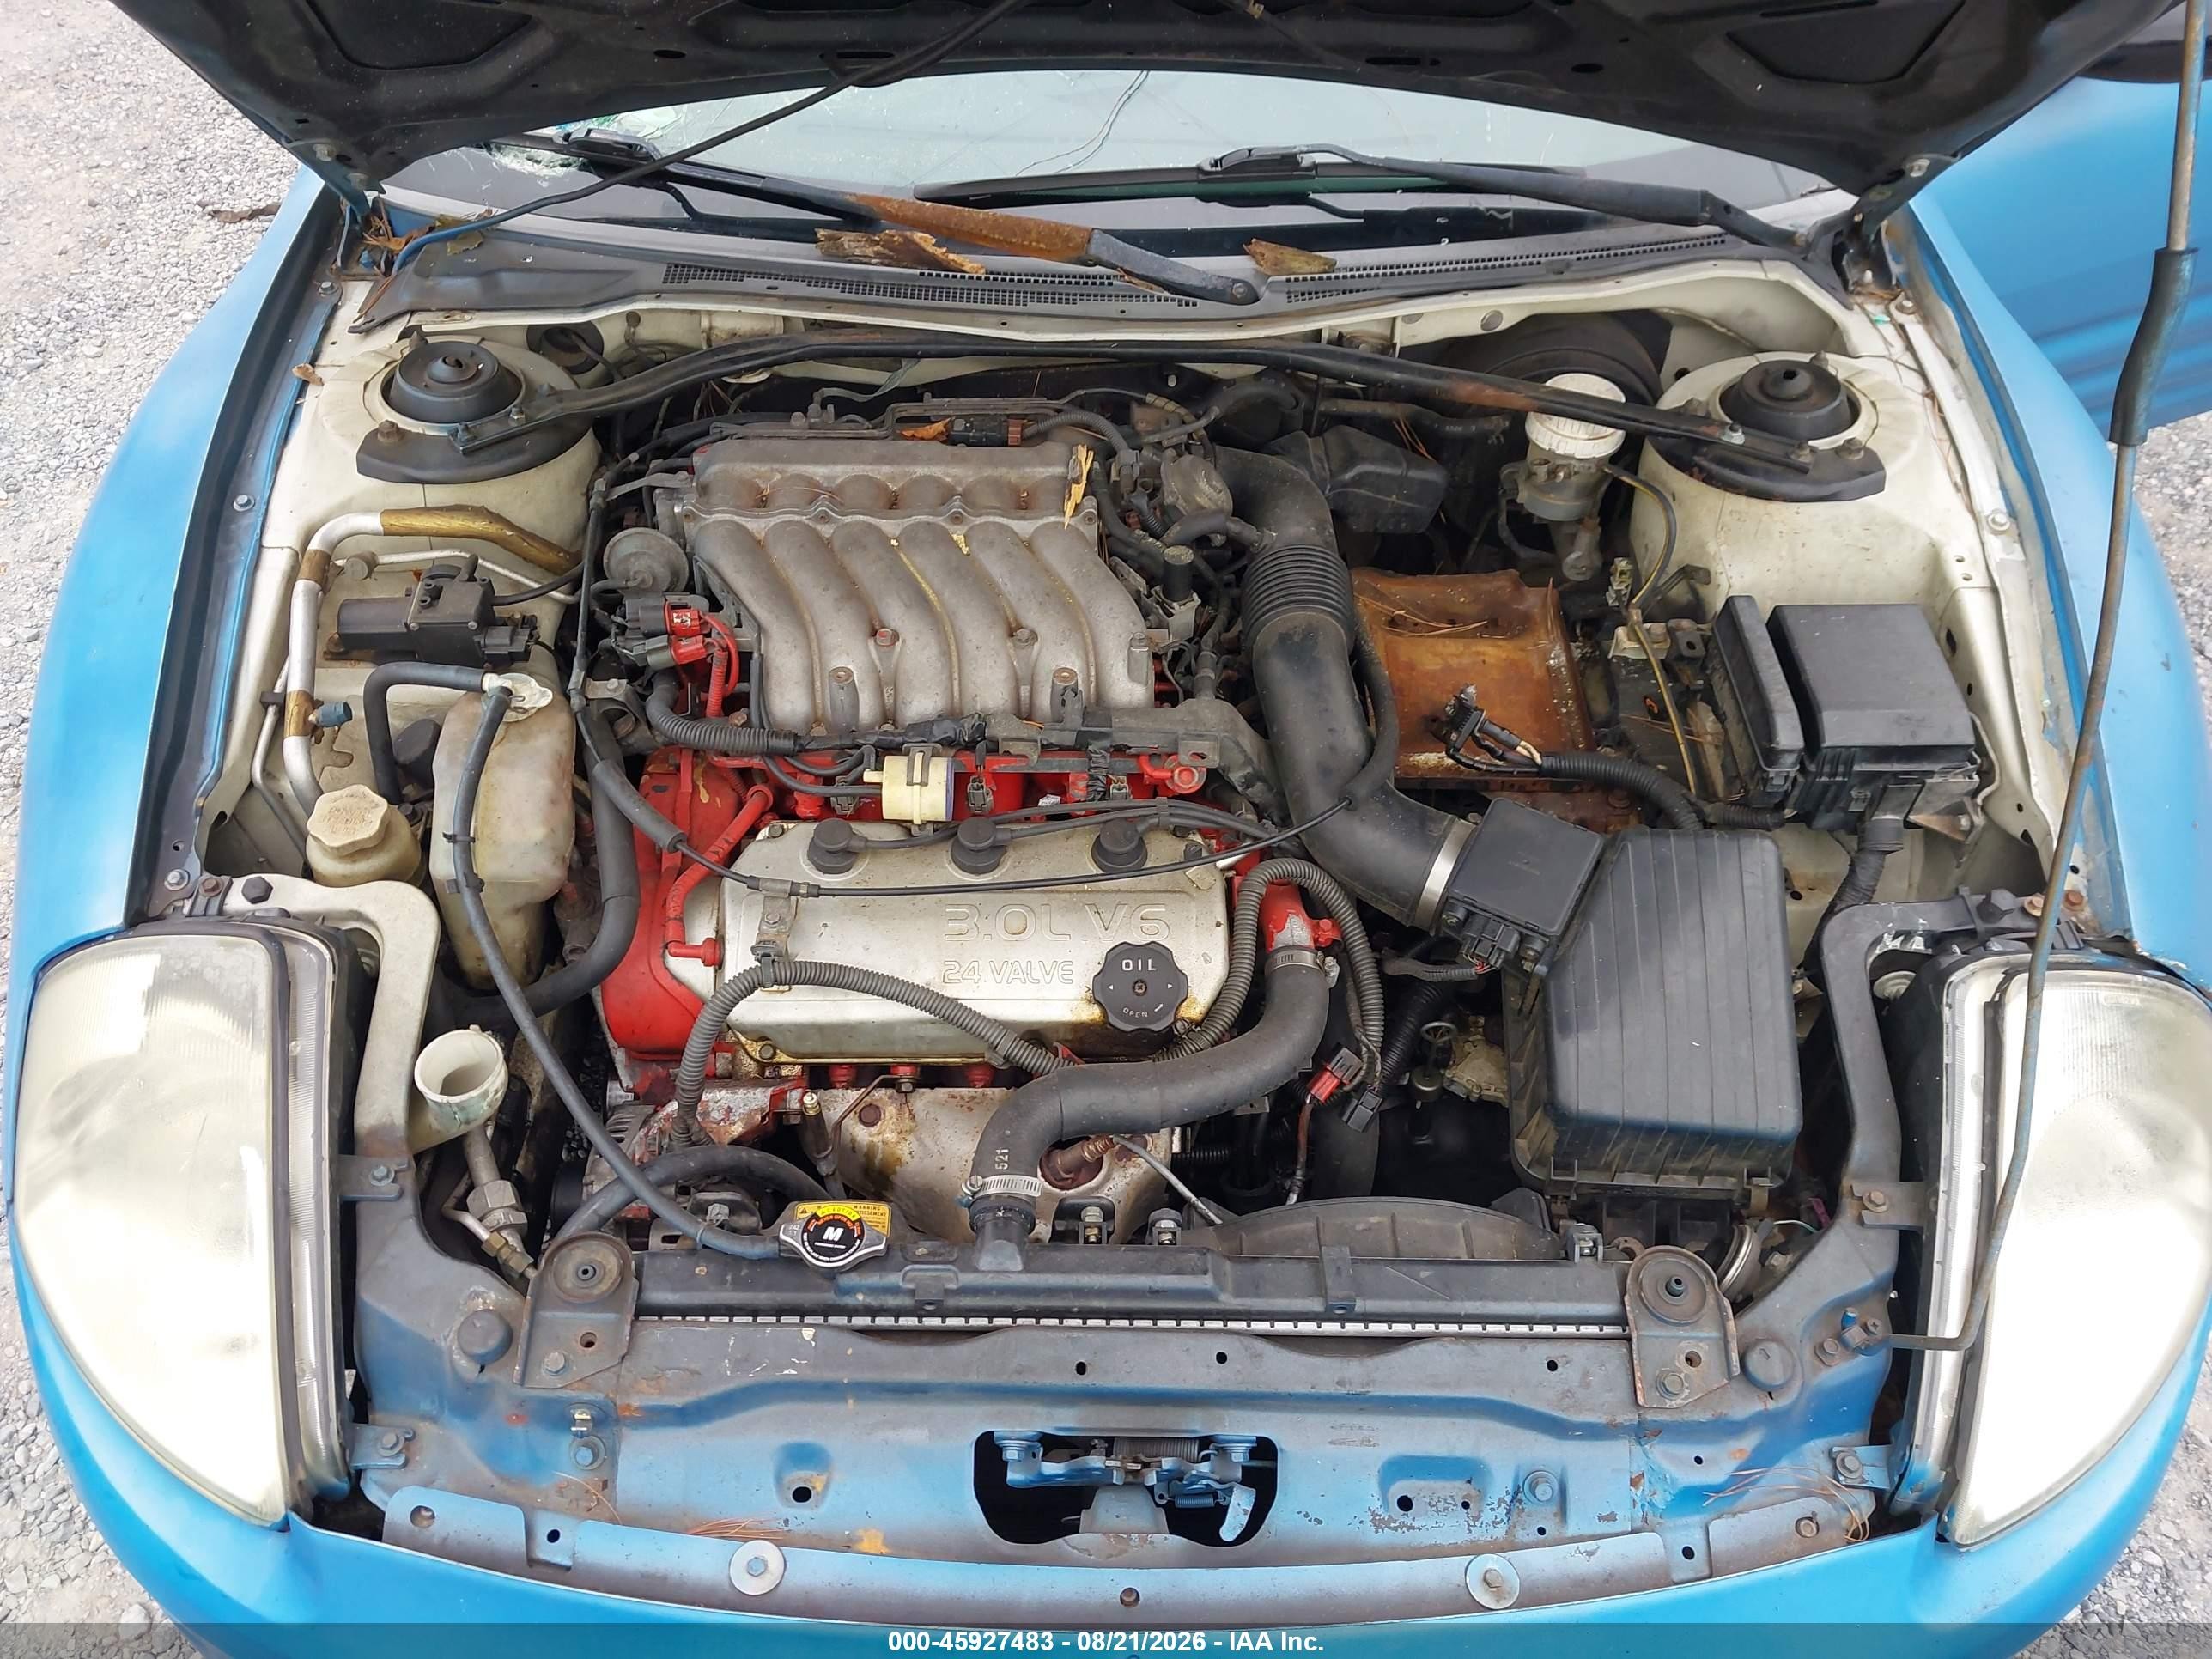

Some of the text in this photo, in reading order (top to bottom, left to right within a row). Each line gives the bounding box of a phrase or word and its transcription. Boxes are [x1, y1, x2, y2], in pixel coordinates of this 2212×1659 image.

[945, 903, 1170, 942] 3.0L V6
[943, 960, 1074, 984] 24 VALVE
[1121, 958, 1157, 971] OIL
[1122, 1007, 1148, 1018] OPEN
[823, 1226, 844, 1242] M
